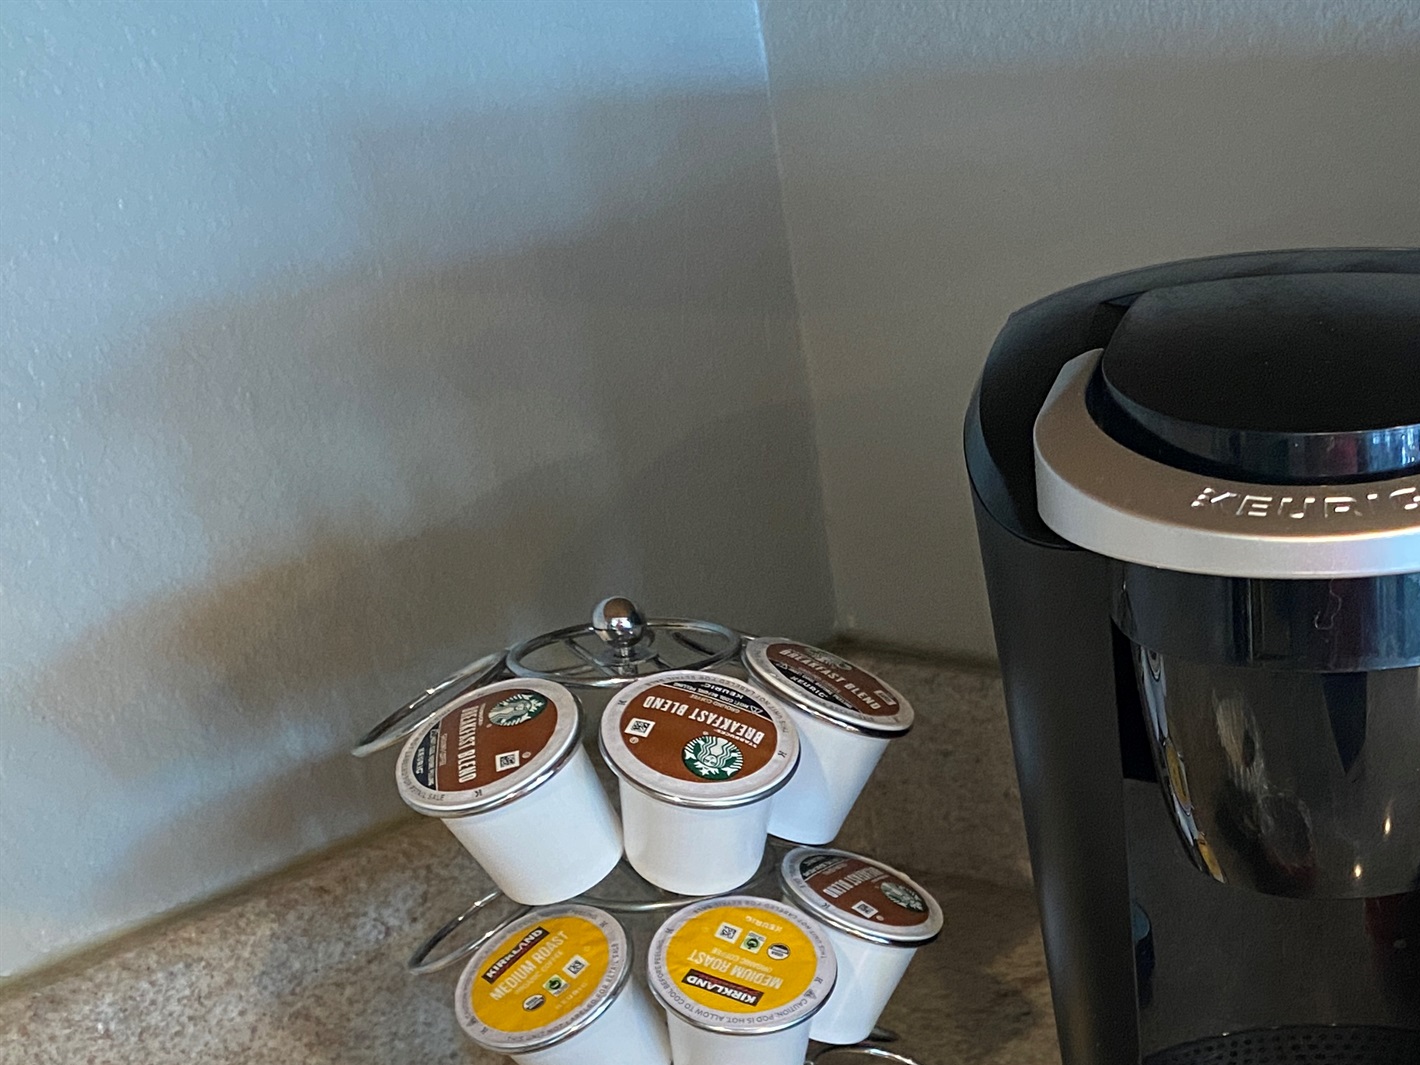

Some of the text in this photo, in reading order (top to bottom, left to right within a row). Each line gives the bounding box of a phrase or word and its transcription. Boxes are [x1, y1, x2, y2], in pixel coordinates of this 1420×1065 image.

[844, 682, 881, 710] BLEND
[643, 696, 765, 745] BREAKFAST BLEND
[486, 928, 544, 979] KIRKLAND
[489, 959, 537, 1001] MEDIUM
[531, 930, 570, 965] ROAST
[687, 948, 731, 973] ROAST
[686, 975, 758, 1004] KIRKLAND
[730, 966, 784, 990] MEDIUM
[684, 1002, 696, 1013] TO
[694, 1007, 724, 1021] ALLOW
